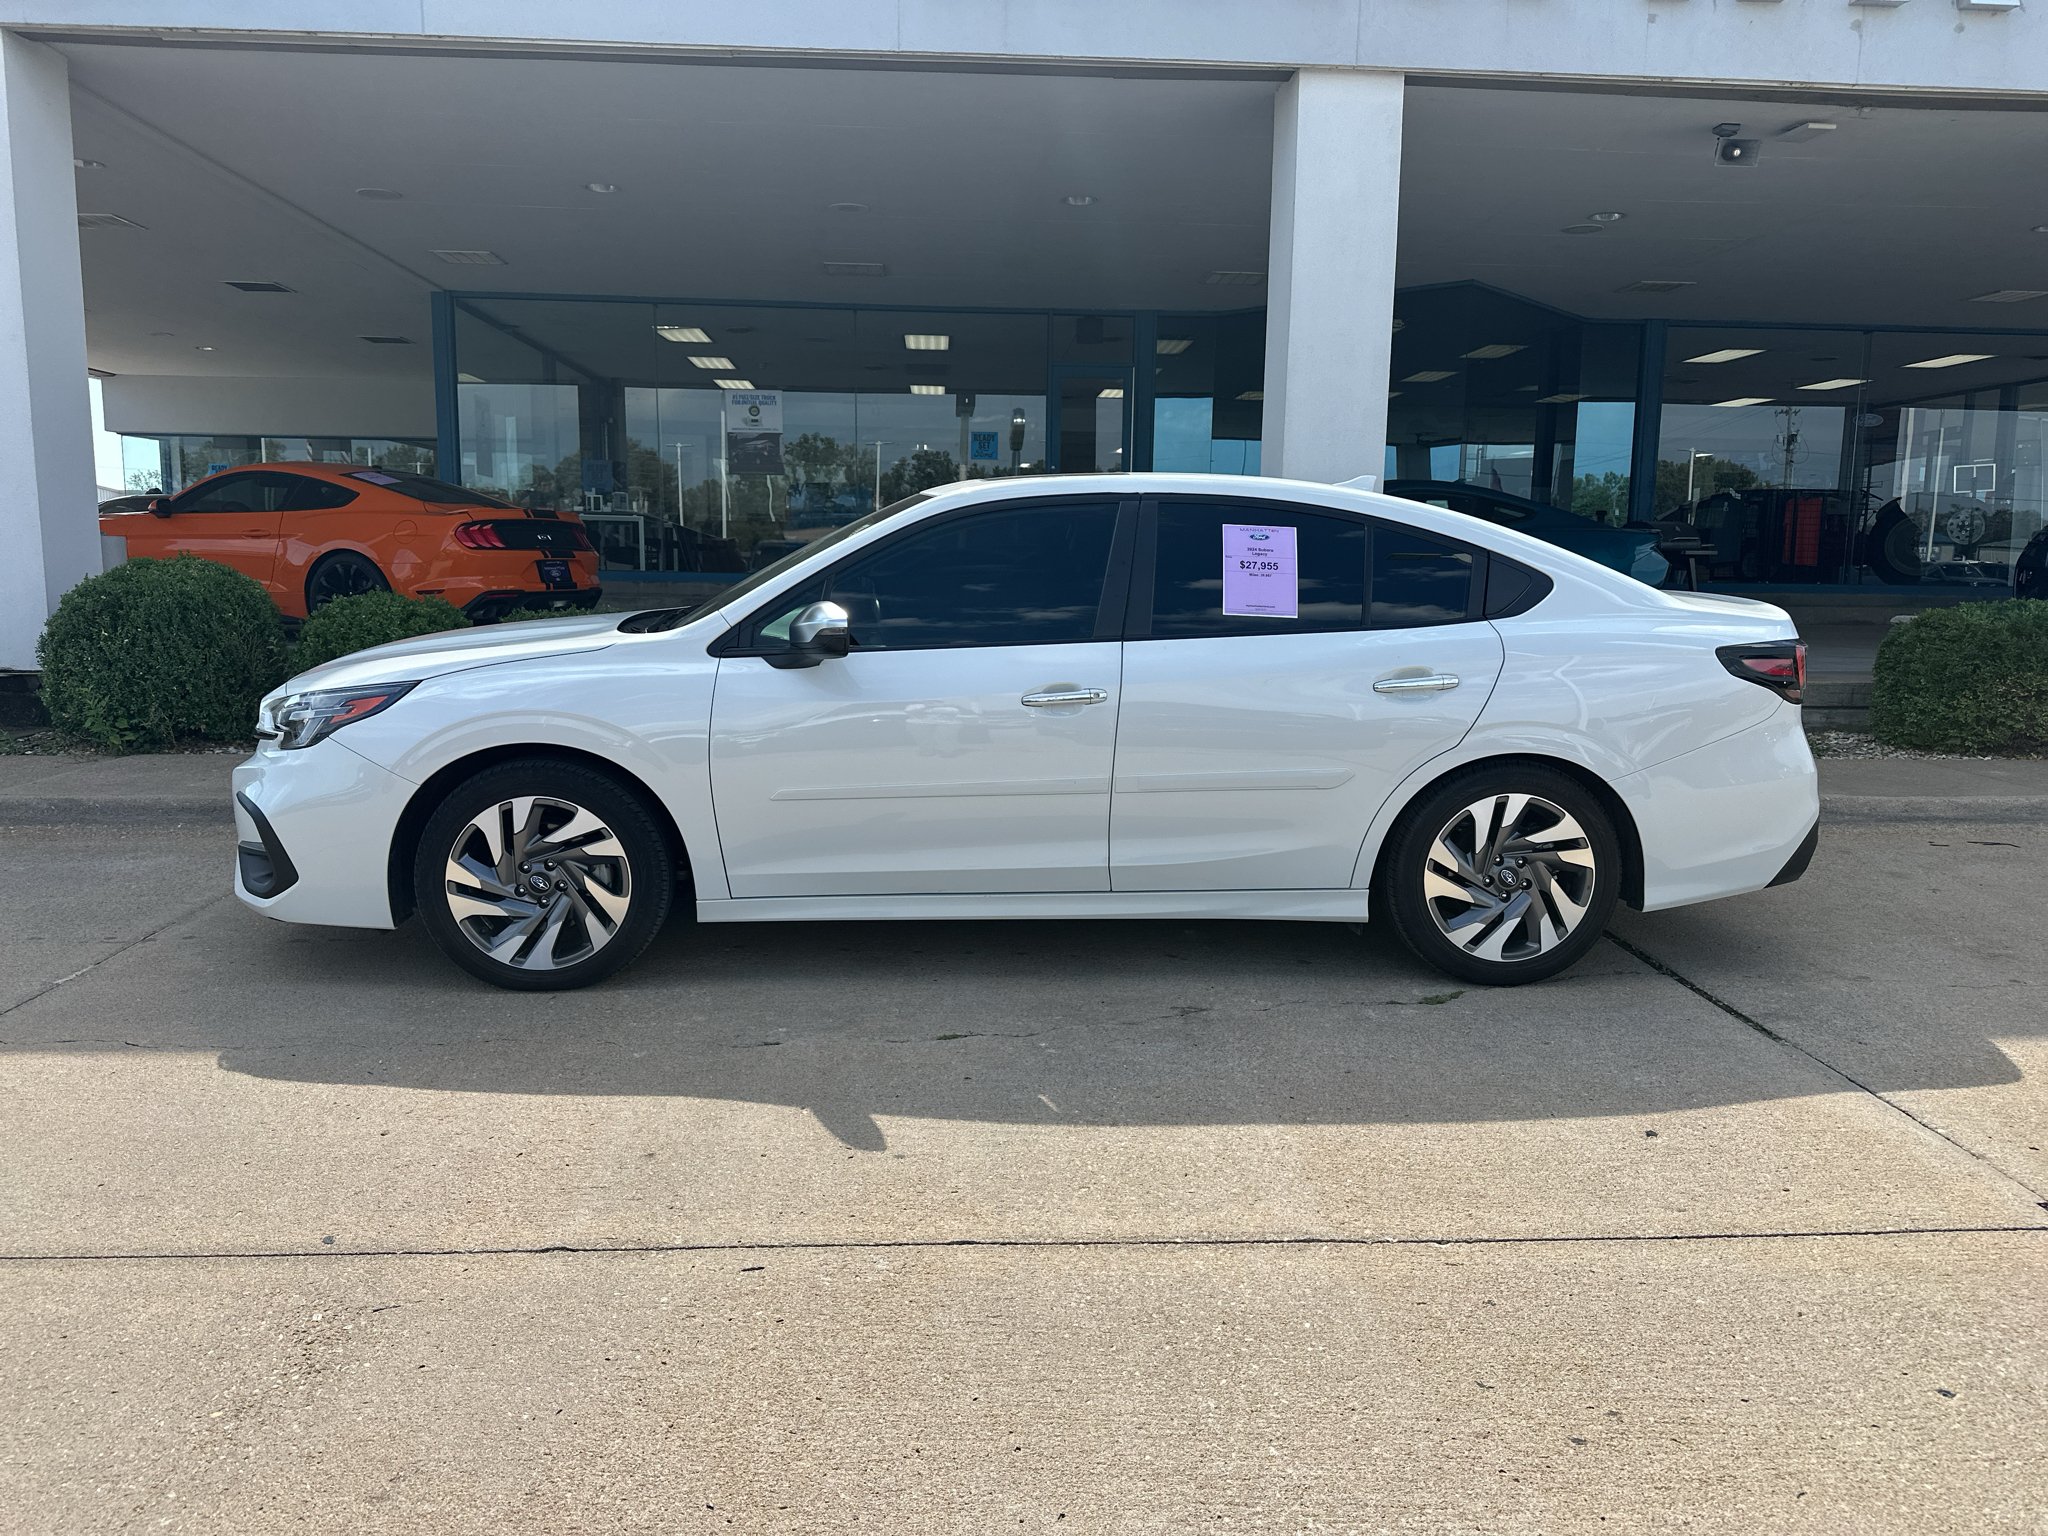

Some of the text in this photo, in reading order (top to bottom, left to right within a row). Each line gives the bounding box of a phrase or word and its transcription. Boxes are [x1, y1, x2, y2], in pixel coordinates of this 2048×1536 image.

[973, 433, 995, 442] READY
[978, 441, 991, 450] SET
[1239, 560, 1279, 571] $27,955
